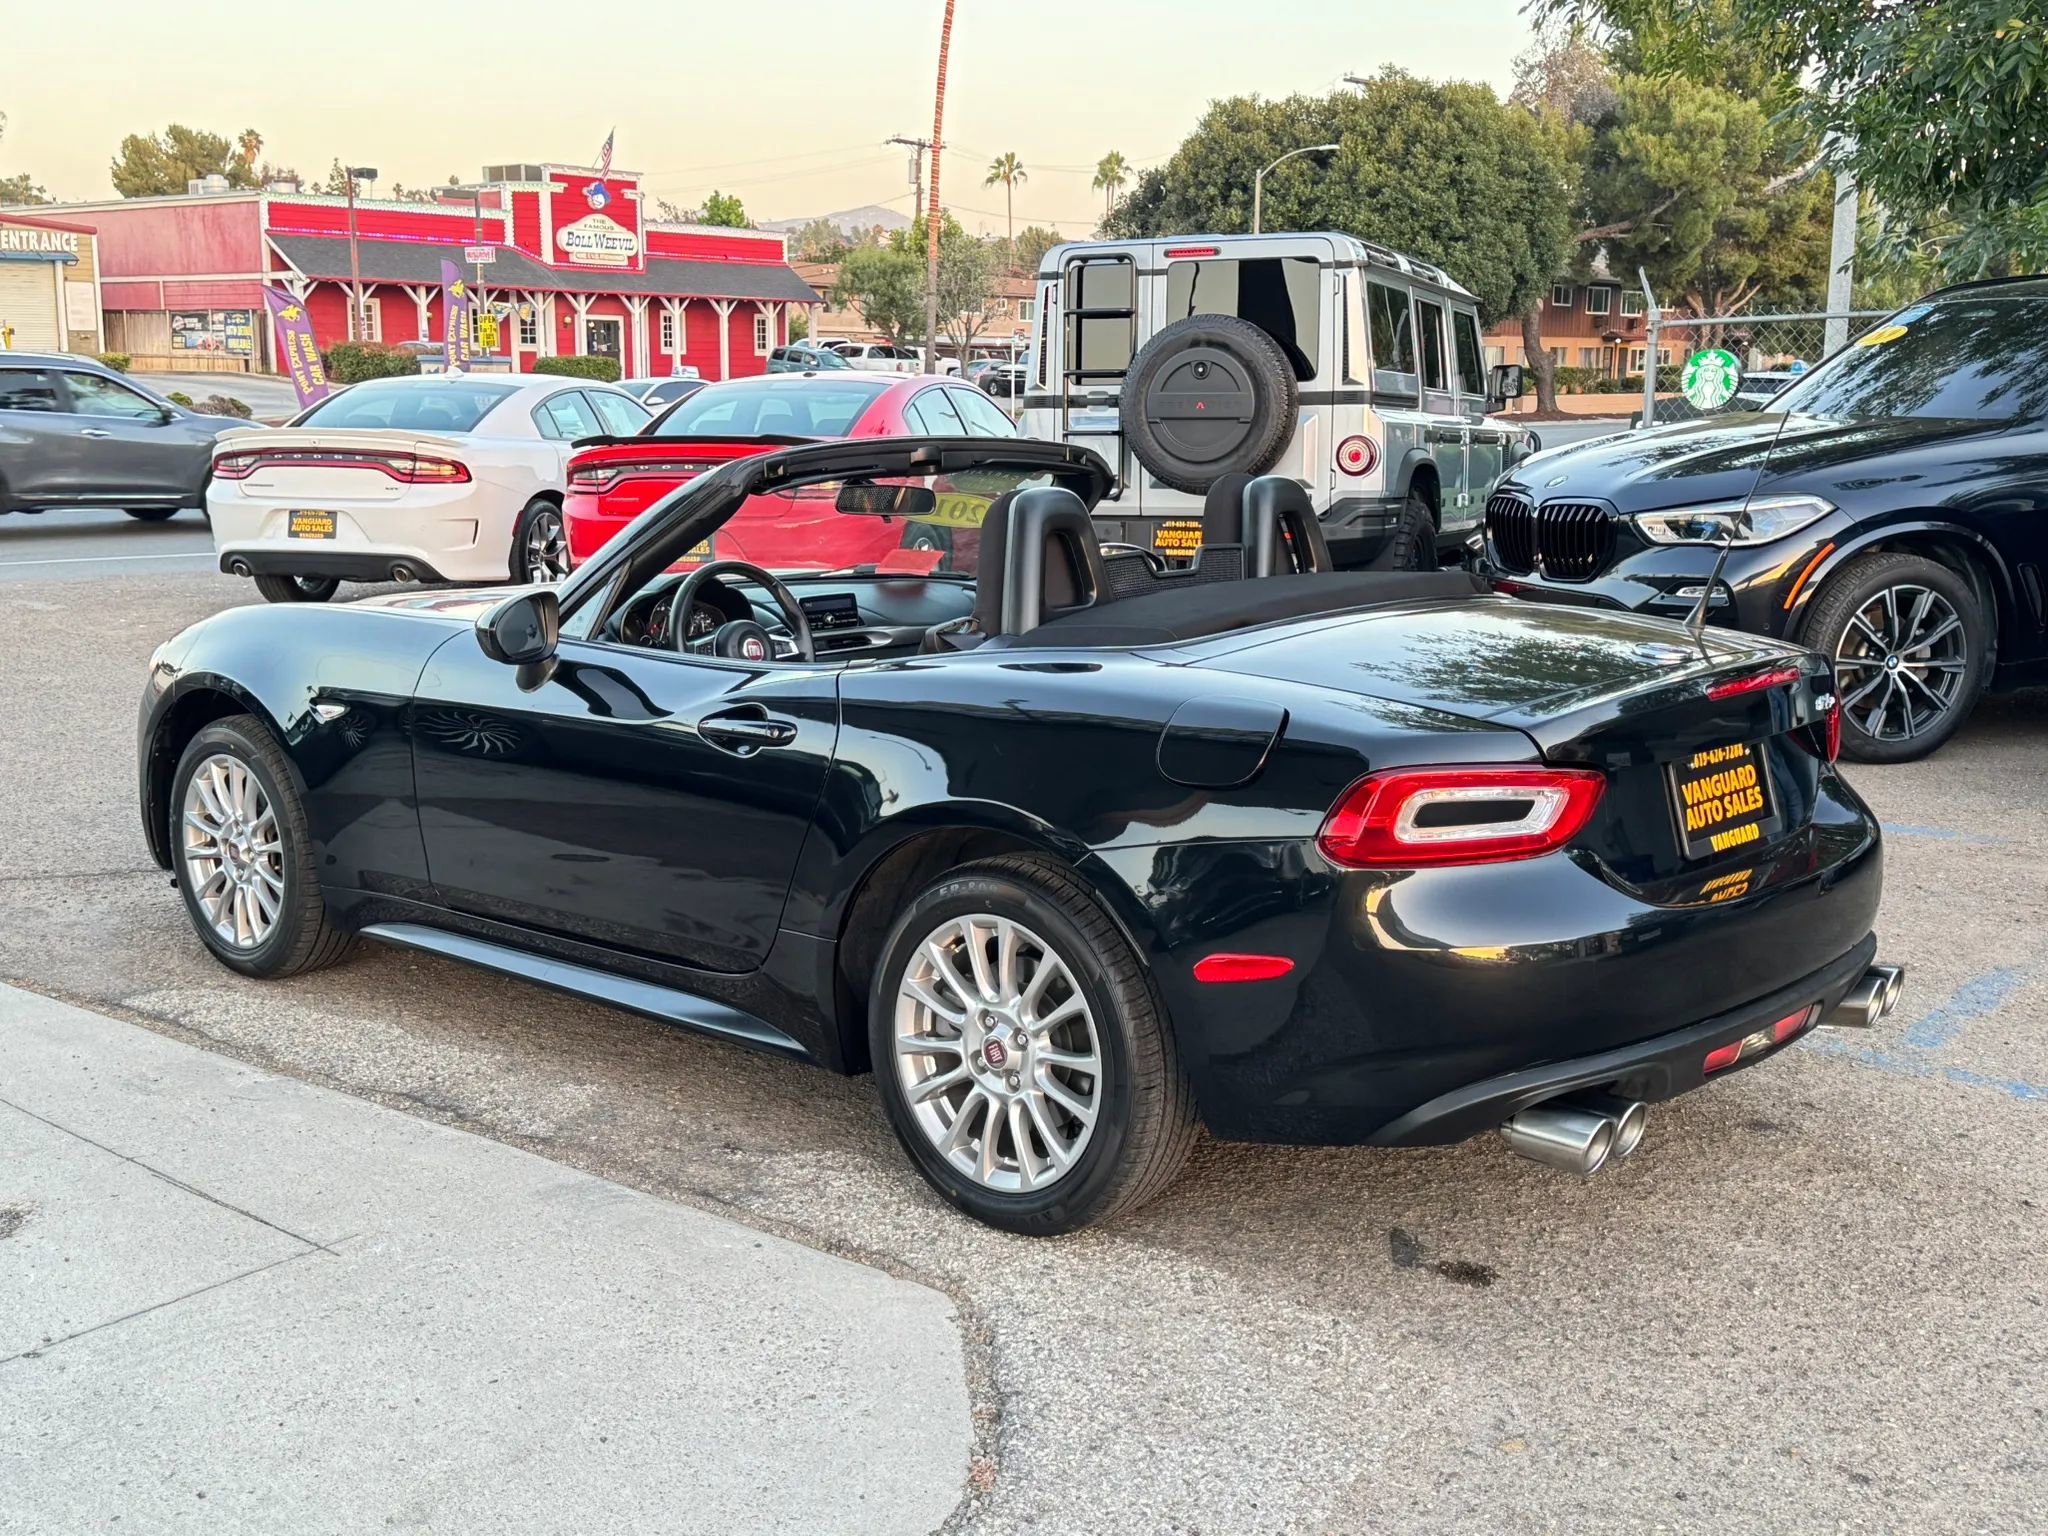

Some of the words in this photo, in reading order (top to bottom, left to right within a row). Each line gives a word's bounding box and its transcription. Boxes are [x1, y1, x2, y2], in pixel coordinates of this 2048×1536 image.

[584, 223, 615, 231] FAMOUS
[0, 229, 79, 252] ENTRANCE
[565, 231, 593, 248] BOLL
[594, 233, 635, 251] WEEVIL
[447, 304, 459, 342] EXPRESS
[459, 310, 469, 339] WASH
[286, 329, 303, 369] EXPRESS
[299, 334, 318, 363] WASH
[460, 341, 470, 361] CAR
[296, 370, 314, 395] PONY
[309, 364, 325, 386] CAR
[292, 517, 333, 525] VANGUARD
[1155, 538, 1180, 547] AUTO
[1682, 765, 1757, 805] VANGUARD
[1686, 799, 1723, 832] AUTO
[1724, 786, 1764, 819] SALES
[1710, 823, 1760, 852] VANGUARD
[987, 1043, 1003, 1062] FIAT
